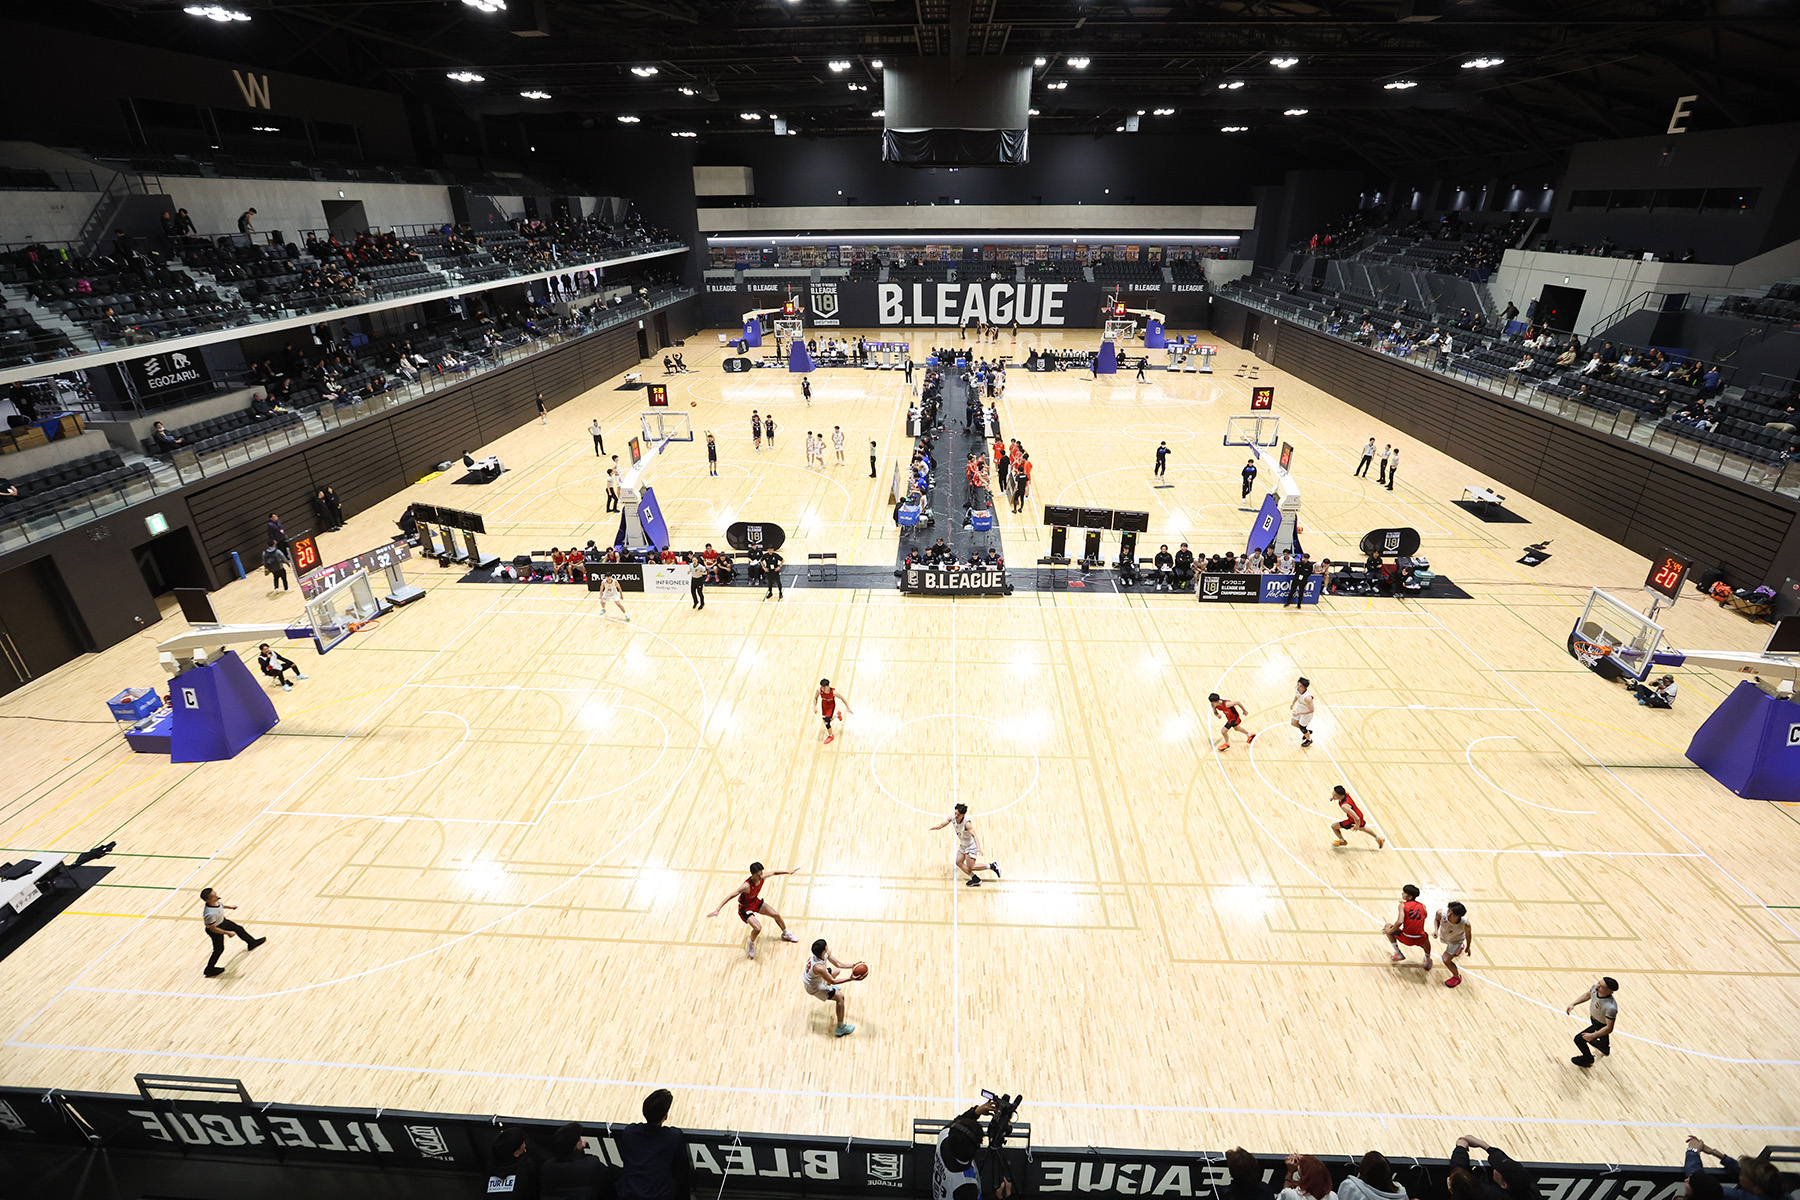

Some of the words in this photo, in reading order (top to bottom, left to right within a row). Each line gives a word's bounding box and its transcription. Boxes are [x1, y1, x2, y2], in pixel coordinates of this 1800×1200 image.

[233, 69, 271, 109] W
[1667, 95, 1698, 134] E
[1135, 284, 1161, 292] B.LEAGUE
[1178, 284, 1204, 292] B.LEAGUE
[816, 295, 834, 311] 18
[878, 283, 1068, 325] B.LEAGUE
[148, 370, 198, 389] EGOZARU
[1255, 396, 1270, 406] 24
[298, 546, 316, 569] 20
[377, 553, 392, 569] 32
[1665, 557, 1683, 573] 5:44
[324, 573, 337, 590] 47
[925, 572, 1003, 589] B.LEAGUE
[1654, 566, 1678, 589] 20
[185, 691, 195, 706] C
